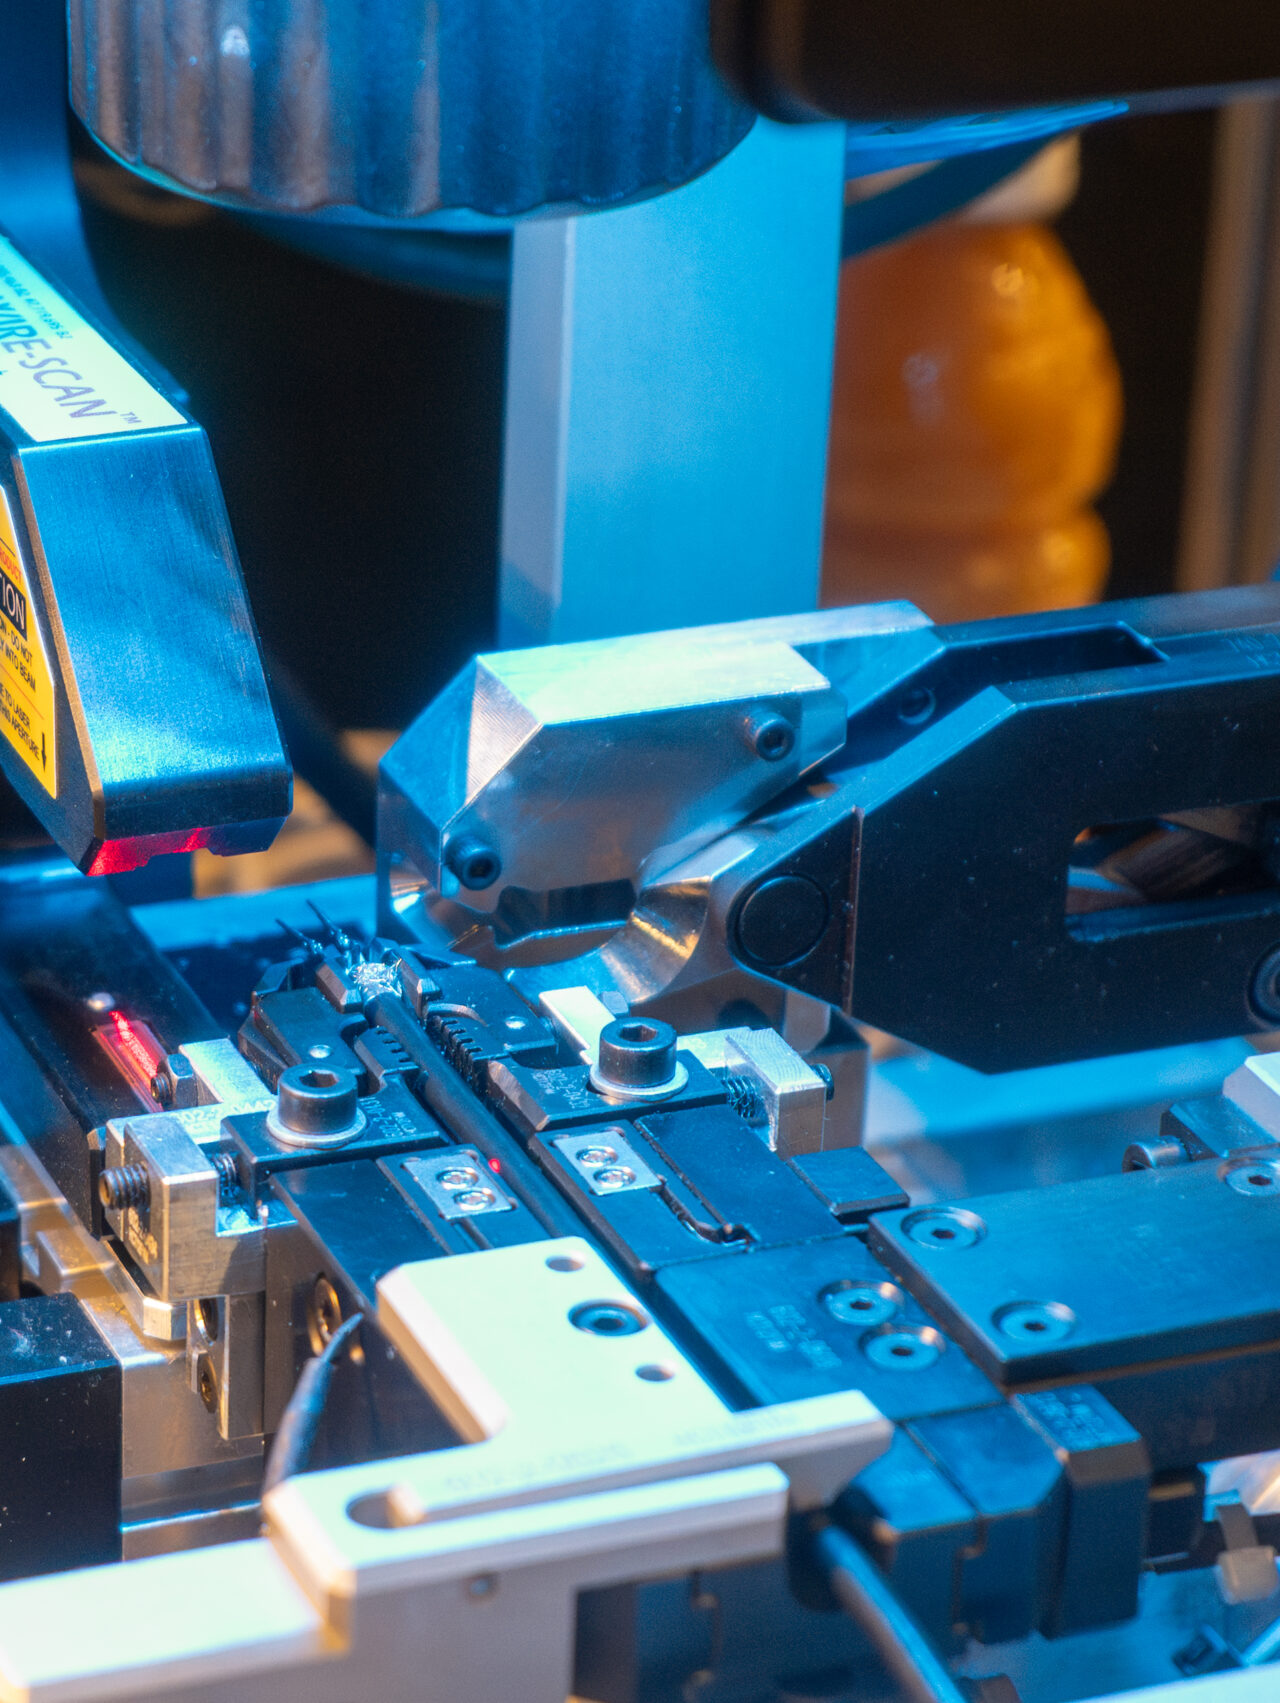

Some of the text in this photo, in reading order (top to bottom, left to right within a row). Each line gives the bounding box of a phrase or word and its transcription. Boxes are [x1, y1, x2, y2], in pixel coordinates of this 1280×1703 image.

[4, 642, 19, 671] INTO
[20, 660, 36, 693] BEAM
[11, 630, 20, 651] DO
[20, 642, 33, 667] NOT
[4, 688, 13, 707] TO
[13, 699, 30, 731] LASER
[11, 715, 40, 760] APERTURE
